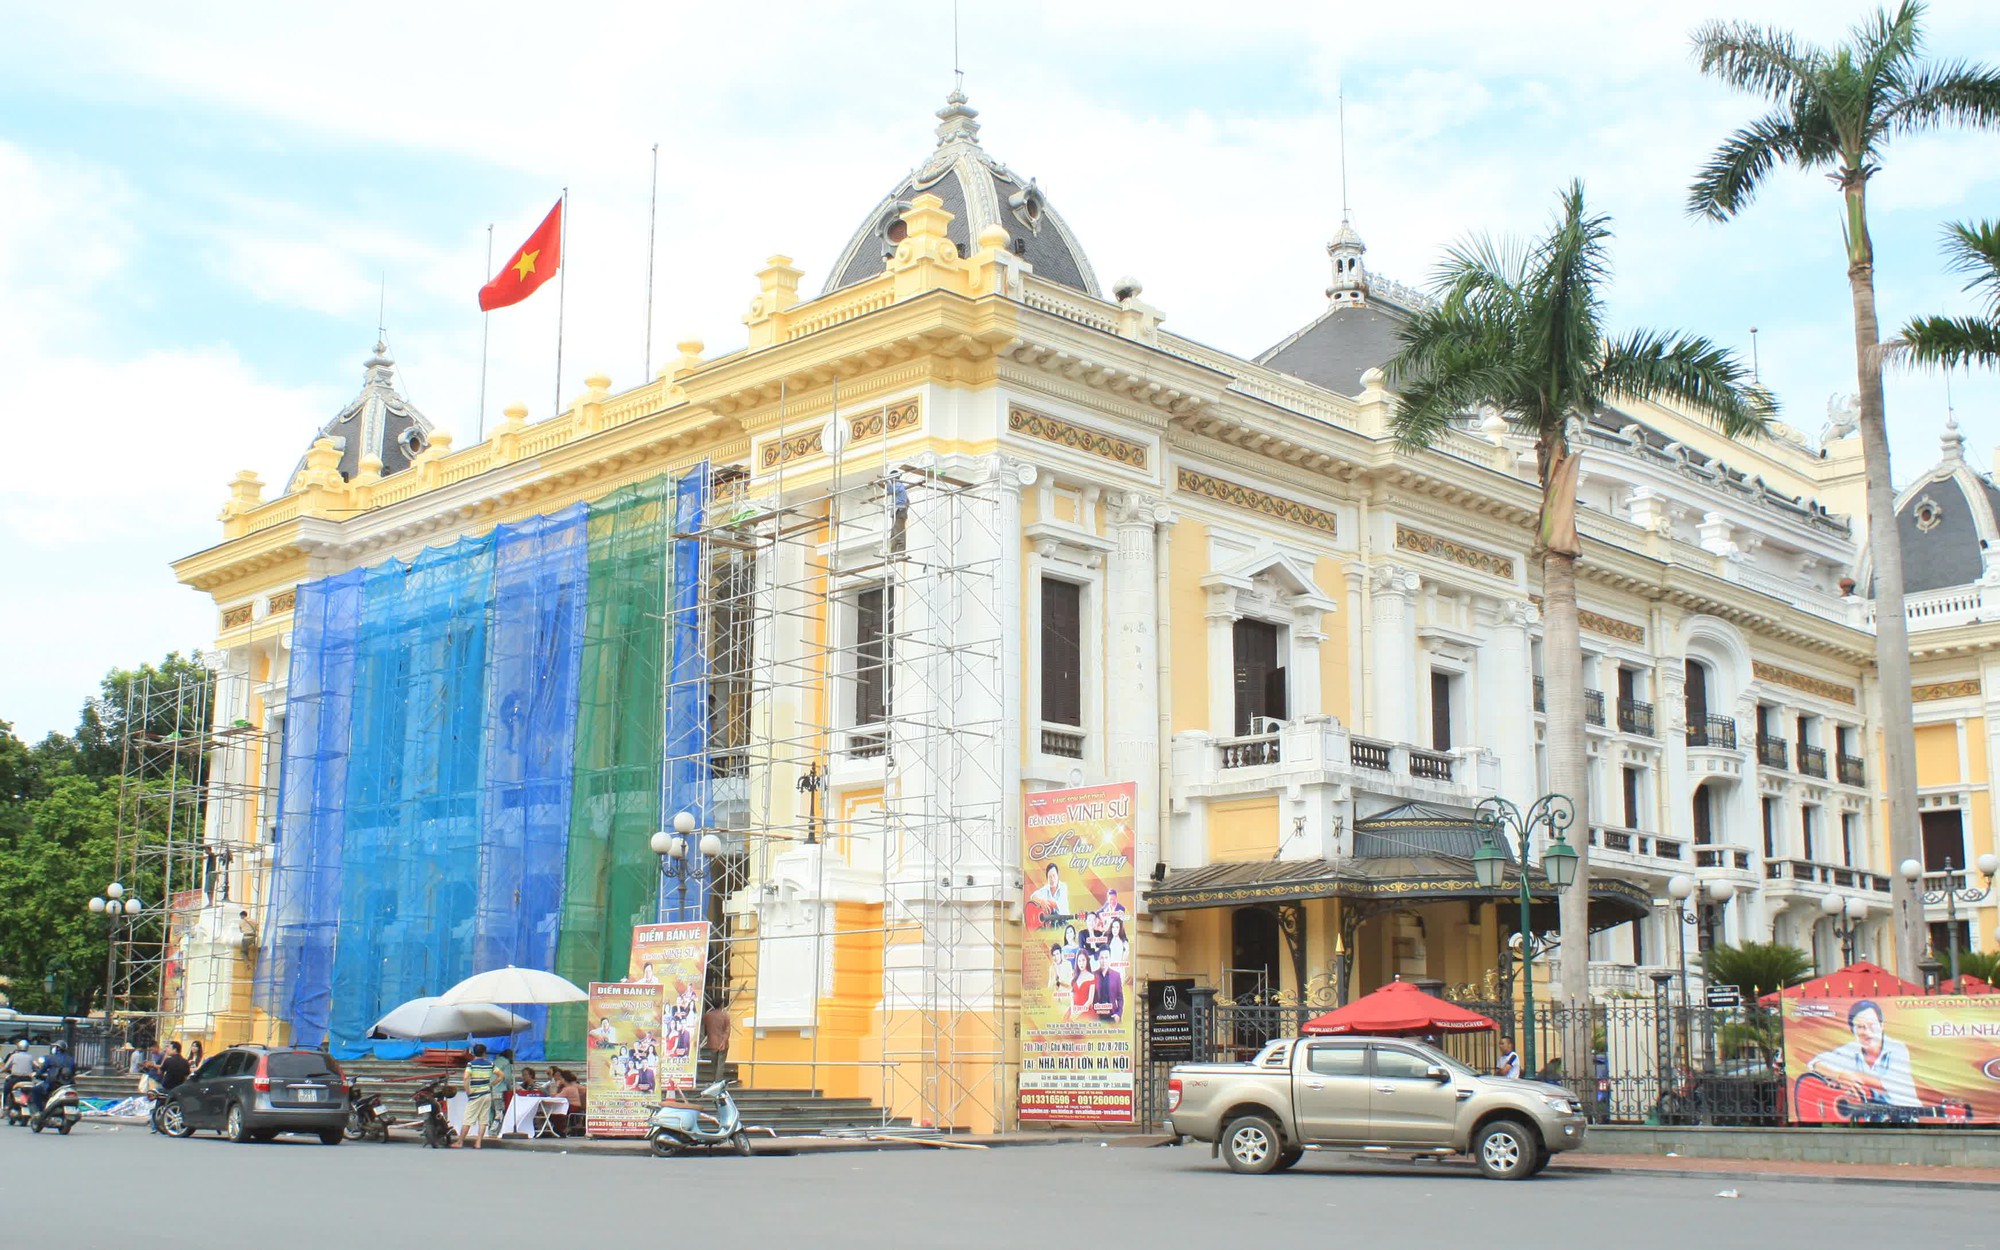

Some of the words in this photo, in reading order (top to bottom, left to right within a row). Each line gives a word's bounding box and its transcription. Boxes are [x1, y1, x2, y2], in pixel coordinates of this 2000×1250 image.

[1067, 803, 1104, 822] VINH
[1107, 794, 1129, 818] SỬ
[1029, 829, 1075, 861] Hai
[1069, 855, 1089, 873] tay
[1093, 851, 1128, 871] trắng
[666, 928, 687, 941] BÁN
[623, 987, 643, 996] BÁN
[1930, 1021, 1965, 1036] ĐÊM
[1058, 1056, 1075, 1069] HÁT
[1112, 1055, 1129, 1071] NỘI
